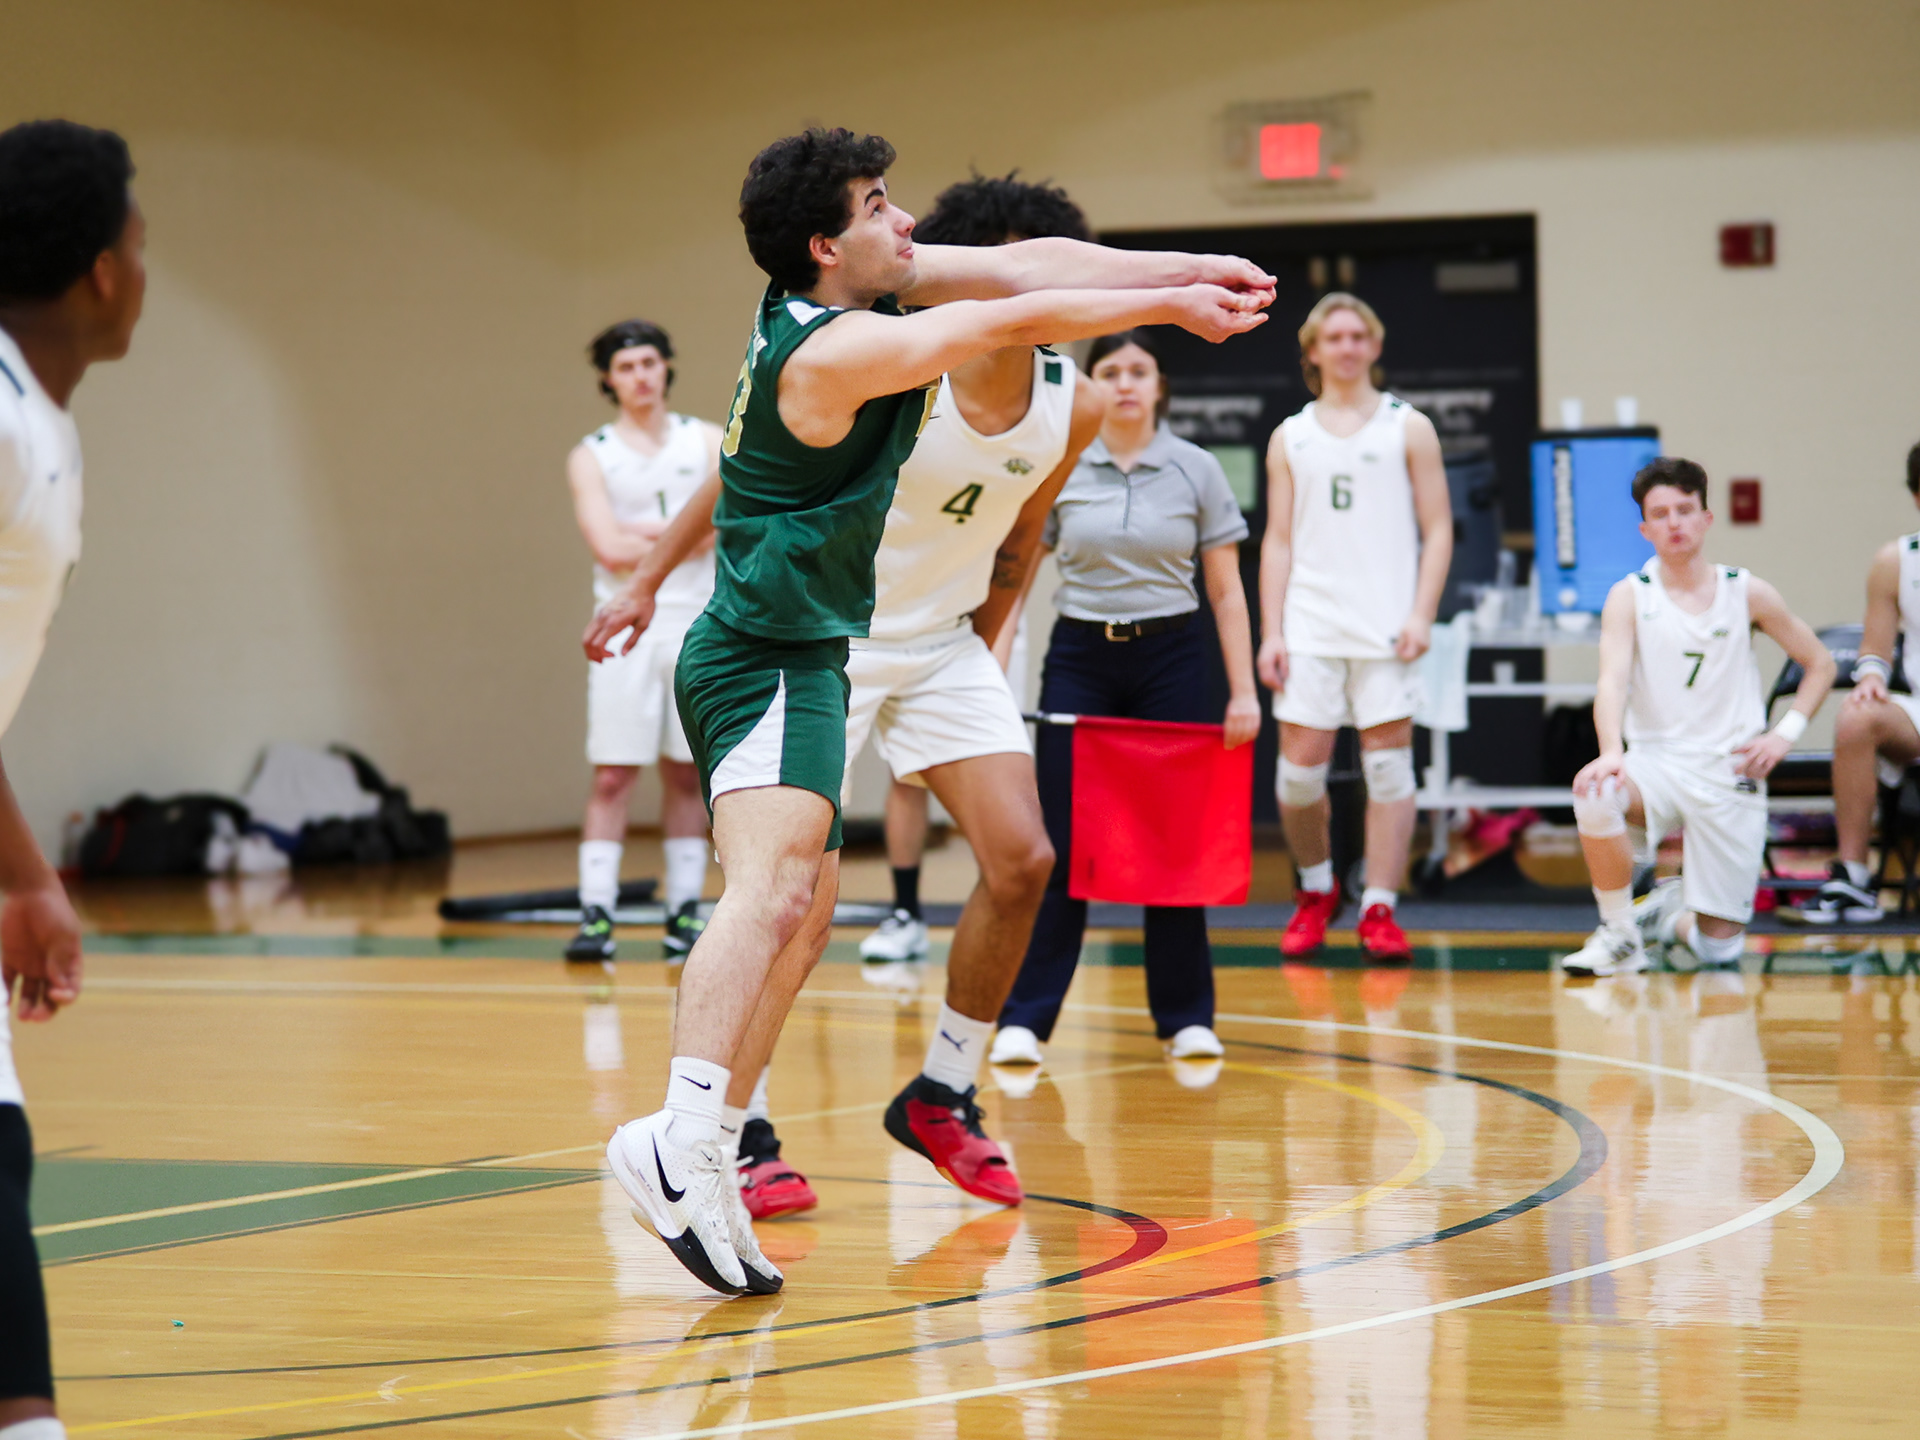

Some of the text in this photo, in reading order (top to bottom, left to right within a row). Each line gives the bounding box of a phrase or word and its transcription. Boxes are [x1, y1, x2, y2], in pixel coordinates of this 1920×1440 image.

[656, 490, 668, 518] 1
[941, 482, 985, 525] 4
[1331, 475, 1352, 511] 6
[1684, 652, 1706, 688] 7
